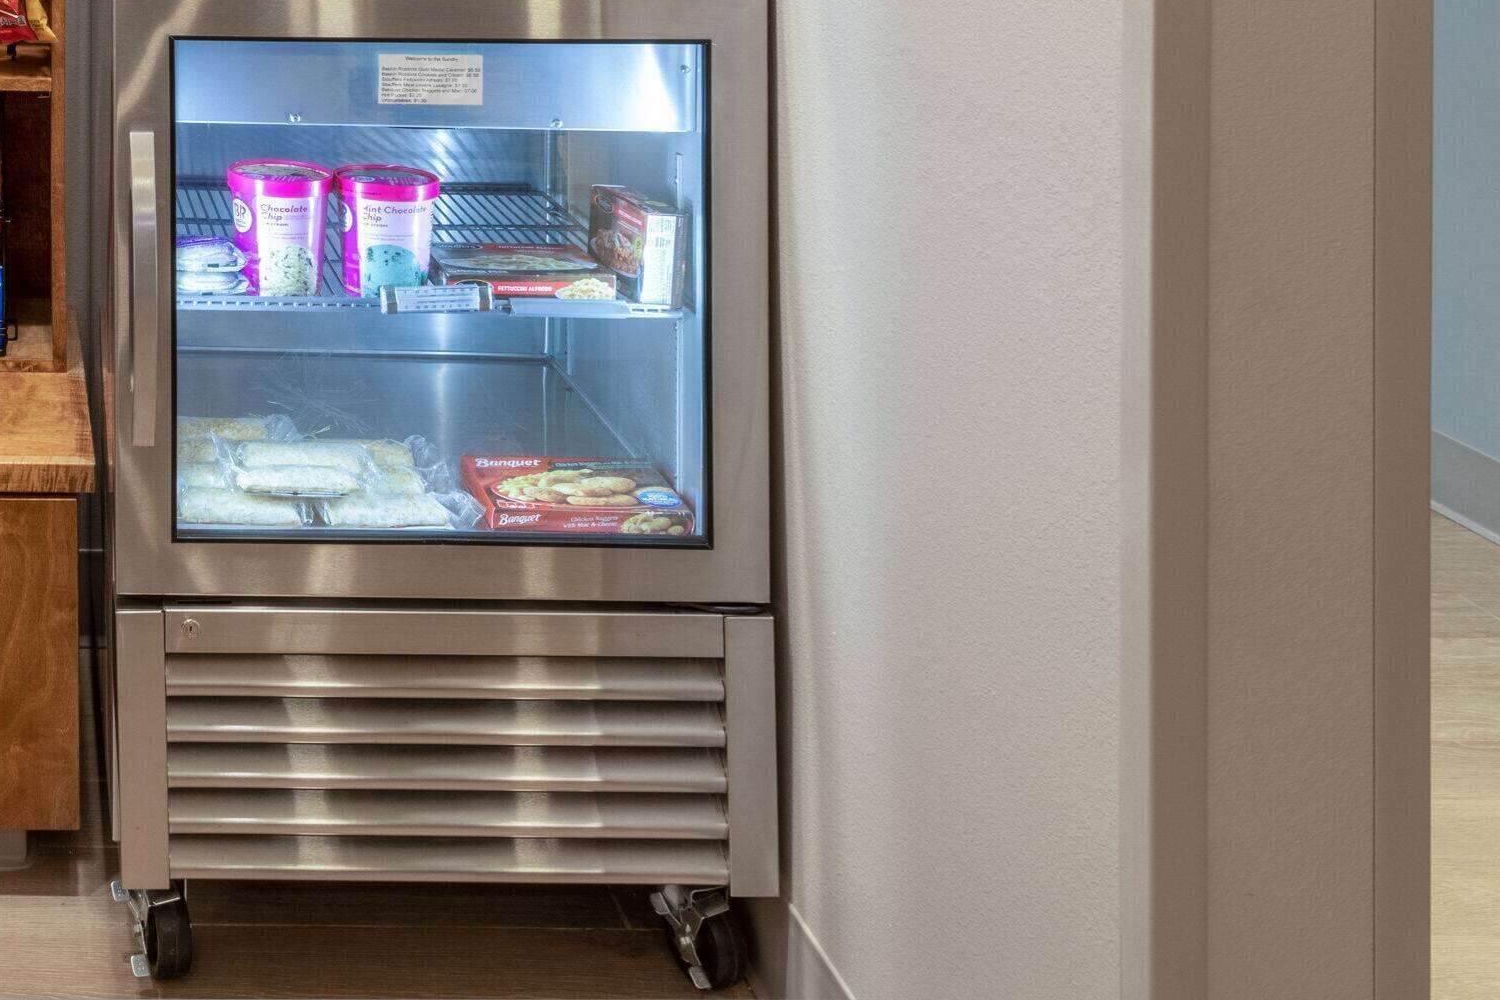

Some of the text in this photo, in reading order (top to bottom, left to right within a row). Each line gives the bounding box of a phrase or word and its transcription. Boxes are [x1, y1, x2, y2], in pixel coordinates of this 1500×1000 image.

[260, 203, 308, 213] Chocolate
[384, 205, 427, 214] Chocolate
[475, 458, 542, 468] Banquet
[499, 513, 542, 525] Banquet
[595, 515, 618, 523] Nuggets
